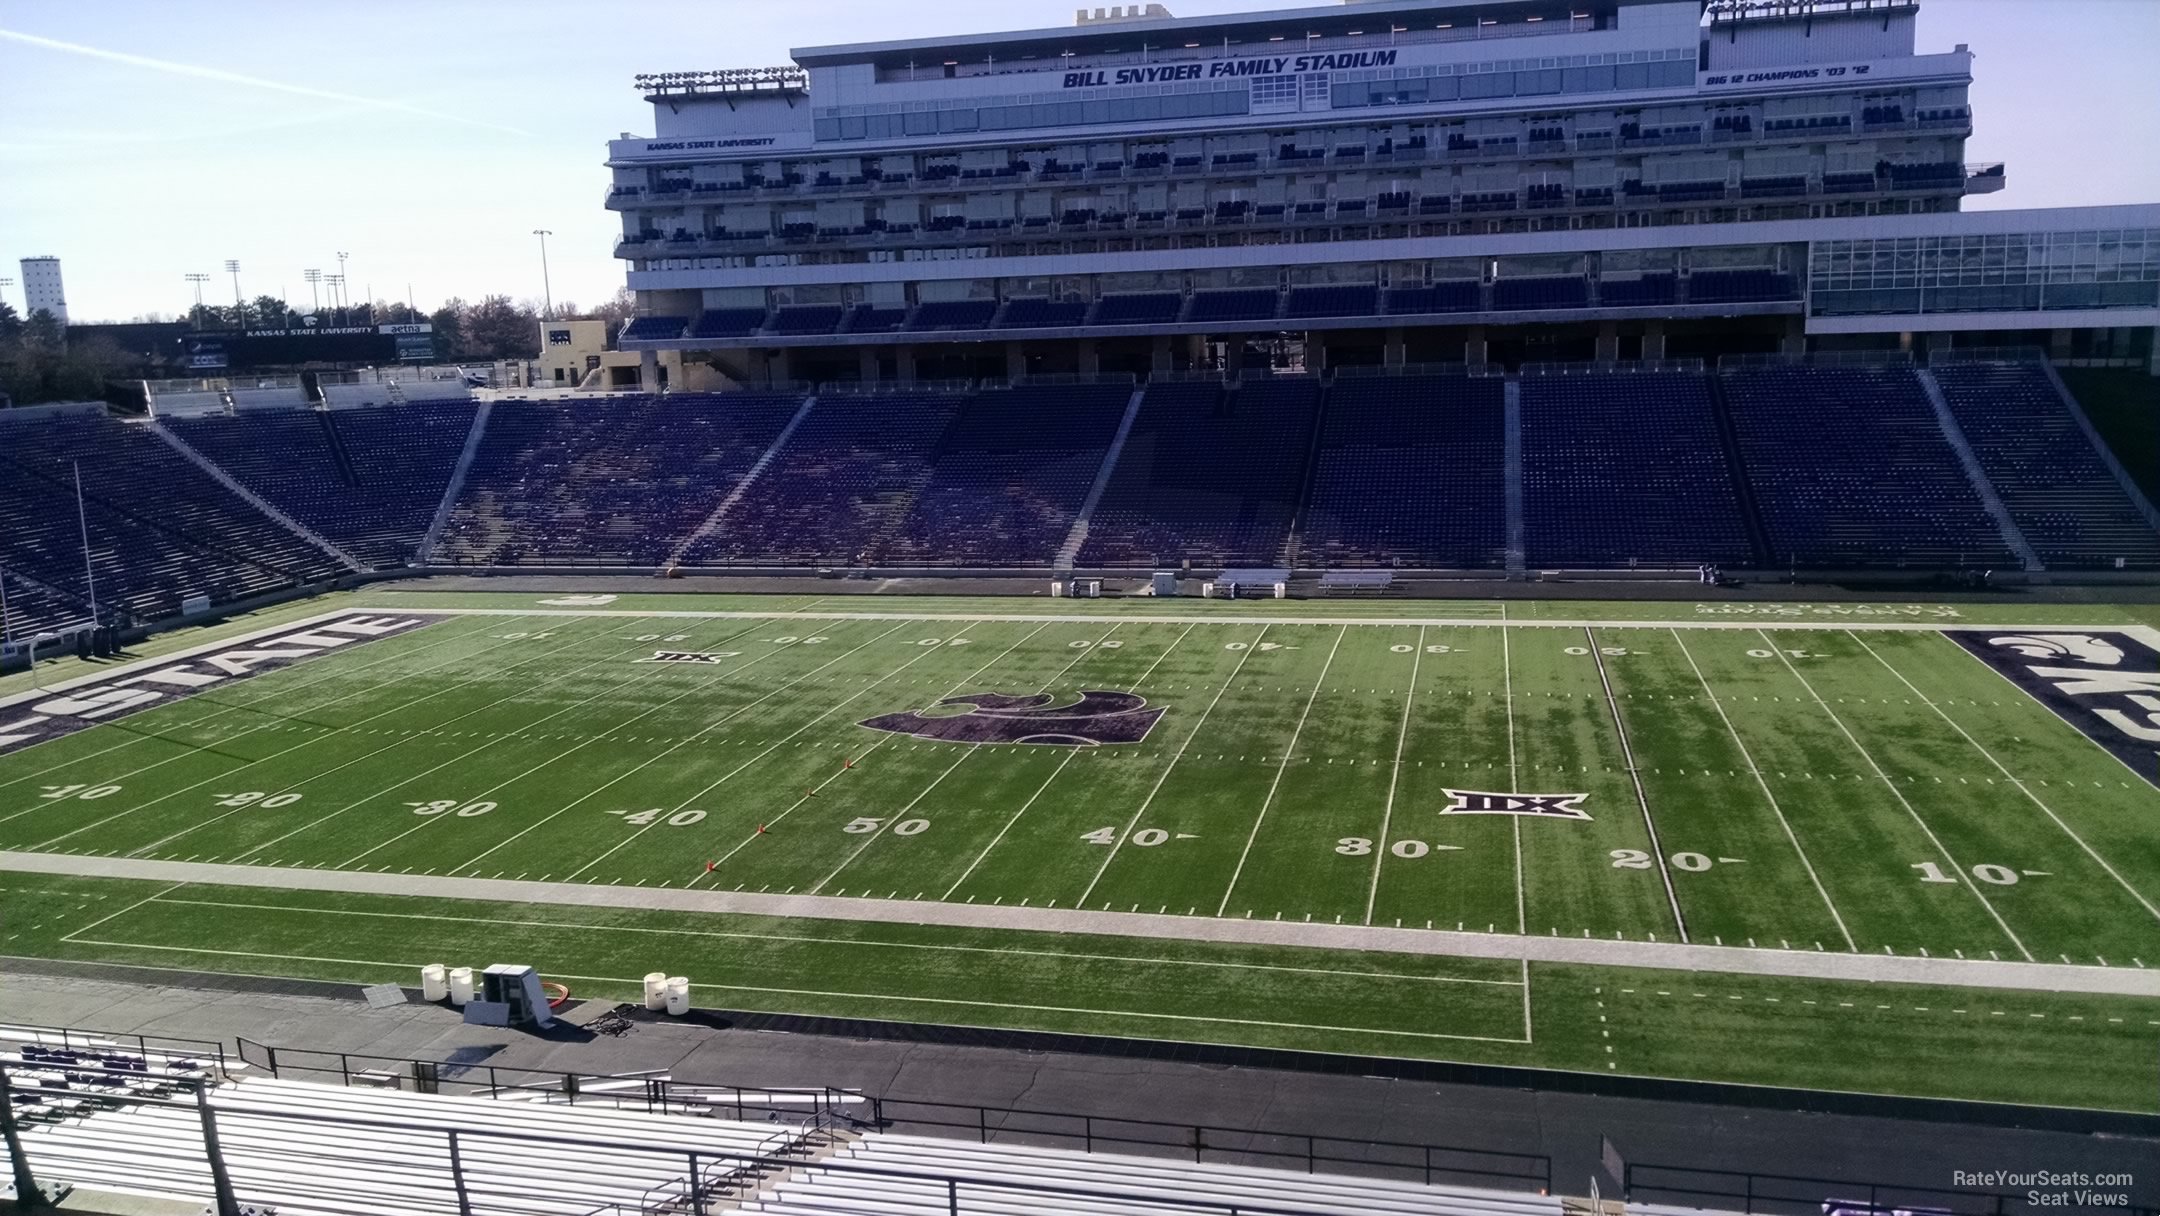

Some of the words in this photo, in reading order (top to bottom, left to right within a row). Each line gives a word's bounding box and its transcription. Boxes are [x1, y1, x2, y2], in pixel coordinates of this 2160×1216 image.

[1063, 70, 1108, 88] BILL
[1115, 63, 1202, 84] SNYDER
[1209, 57, 1289, 78] FAMILY
[1294, 49, 1397, 71] STADIUM
[1706, 76, 1728, 85] BIG
[1731, 74, 1744, 83] 12
[1747, 68, 1820, 82] CHAMPIONS
[1825, 67, 1847, 76] '03
[1852, 65, 1870, 74] '12
[647, 142, 686, 151] KANSAS
[687, 140, 716, 149] STATE
[717, 138, 775, 148] UNIVERSITY
[246, 329, 286, 338] KANSAS
[290, 328, 316, 336] STATE
[320, 326, 373, 335] UNIVERSITY
[391, 325, 421, 333] aetna
